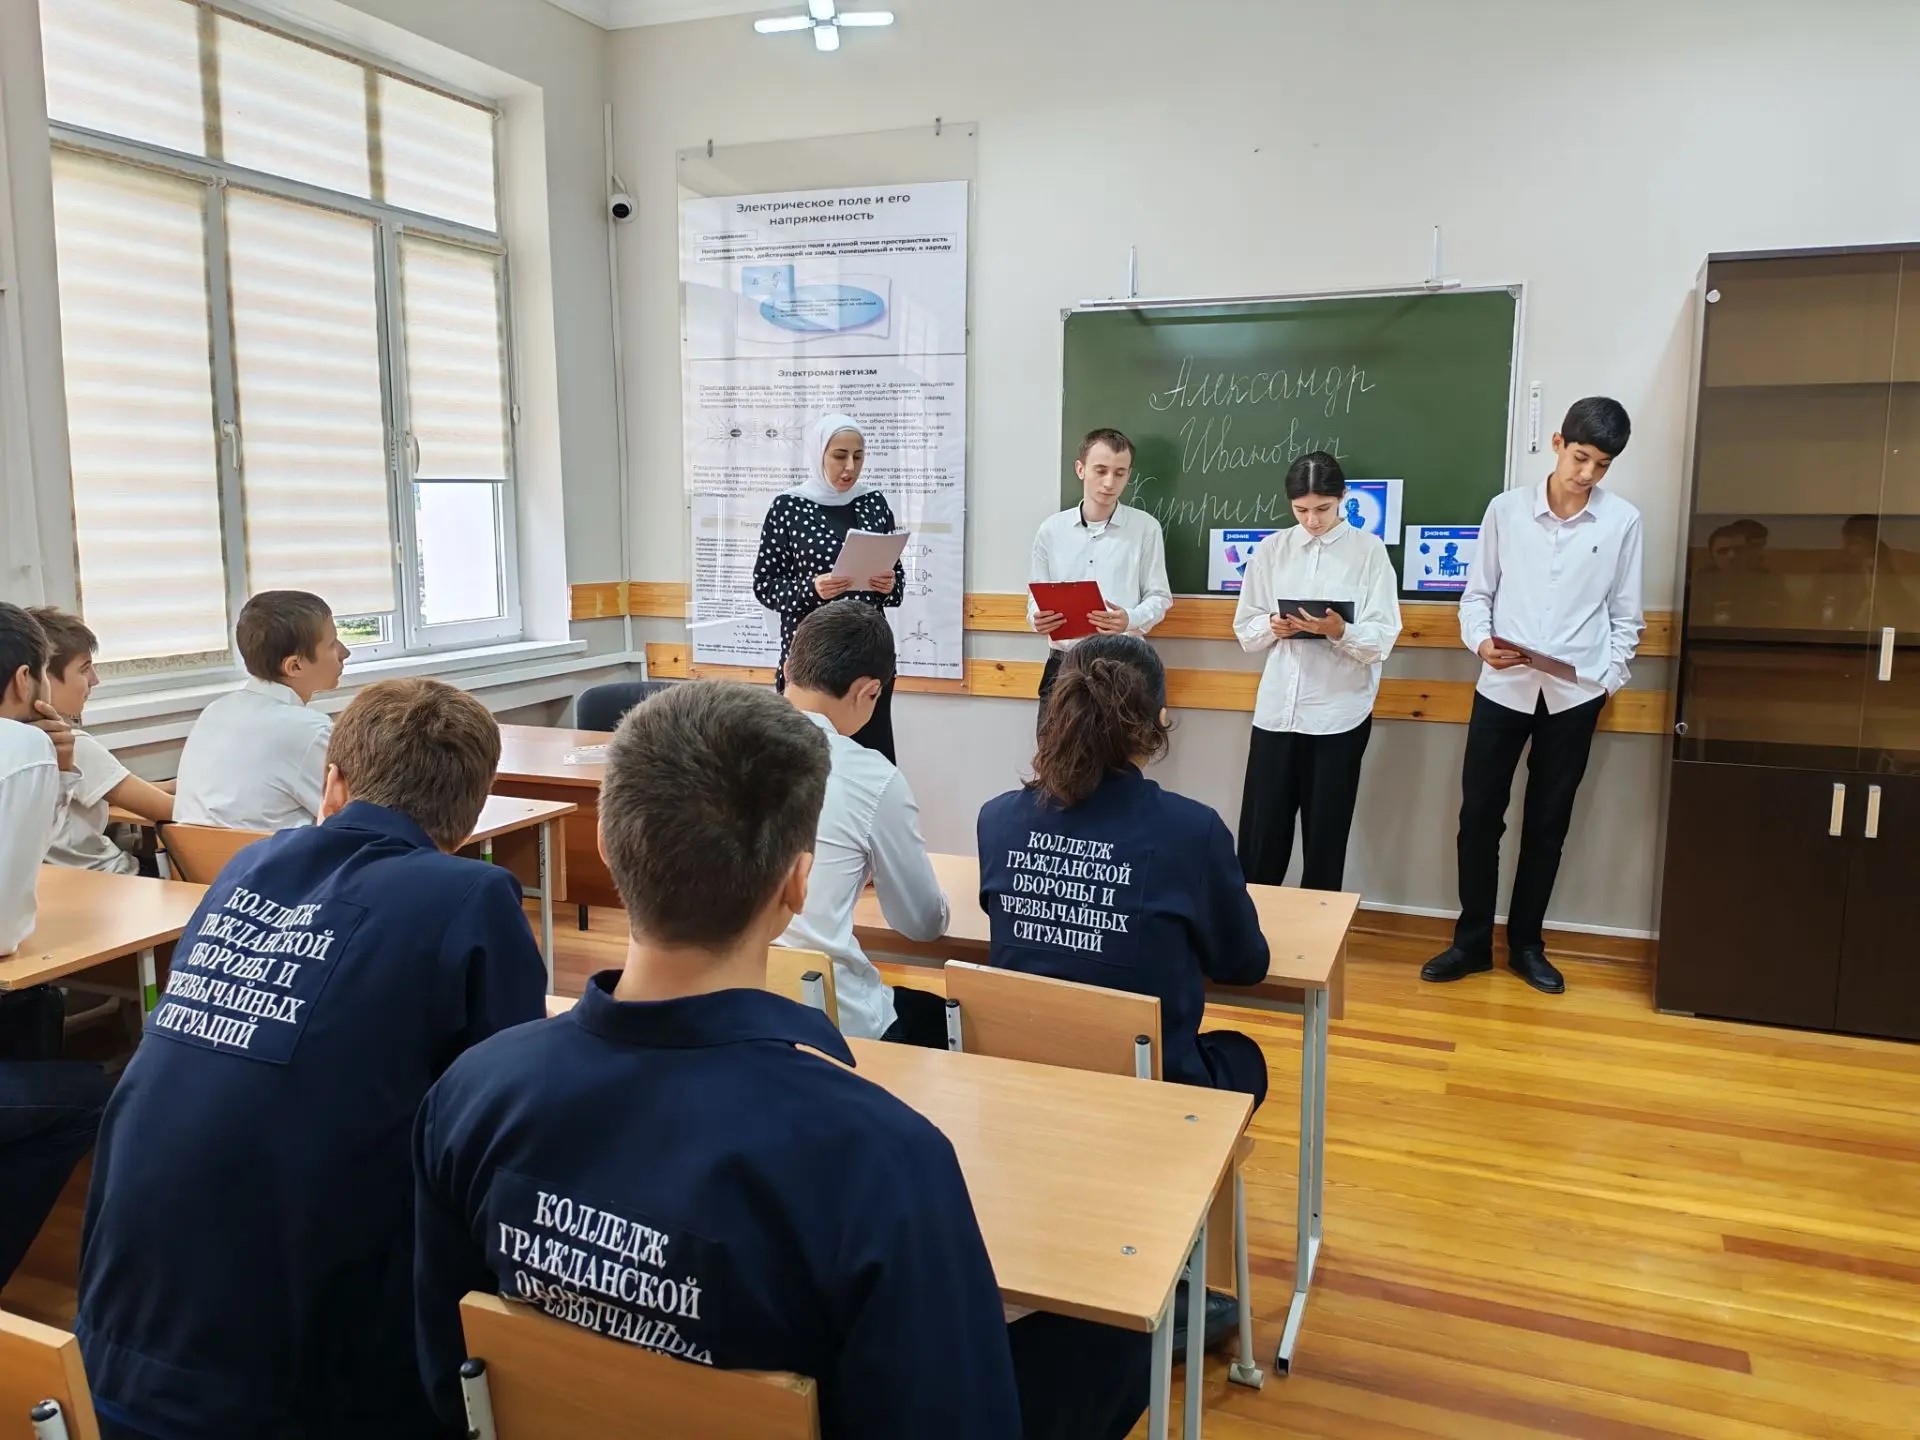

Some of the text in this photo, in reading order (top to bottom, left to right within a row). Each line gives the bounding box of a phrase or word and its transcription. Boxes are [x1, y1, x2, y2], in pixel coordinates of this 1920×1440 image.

[736, 193, 911, 213] Электрическое поле и его
[769, 210, 875, 226] напряженность
[778, 368, 878, 378] Электромагнетизм
[1149, 355, 1376, 418] Александр
[1179, 415, 1350, 474] Иванович
[1027, 831, 1114, 861] КОЛЛЕДЖ
[1006, 850, 1132, 885] ГРАЖДАНСКОЙ
[1012, 873, 1116, 906] ОБОРОНЫ И
[999, 893, 1129, 933] ЧРЕЗВЫЧАЙНЫХ
[1013, 920, 1103, 952] СИТУАЦИЙ
[273, 961, 301, 988] И
[155, 1002, 259, 1049] СИТУАЦИЙ
[533, 1190, 670, 1269] КОЛЛЕДЖ
[498, 1222, 702, 1320] ГРАЖДАНСКОЙ
